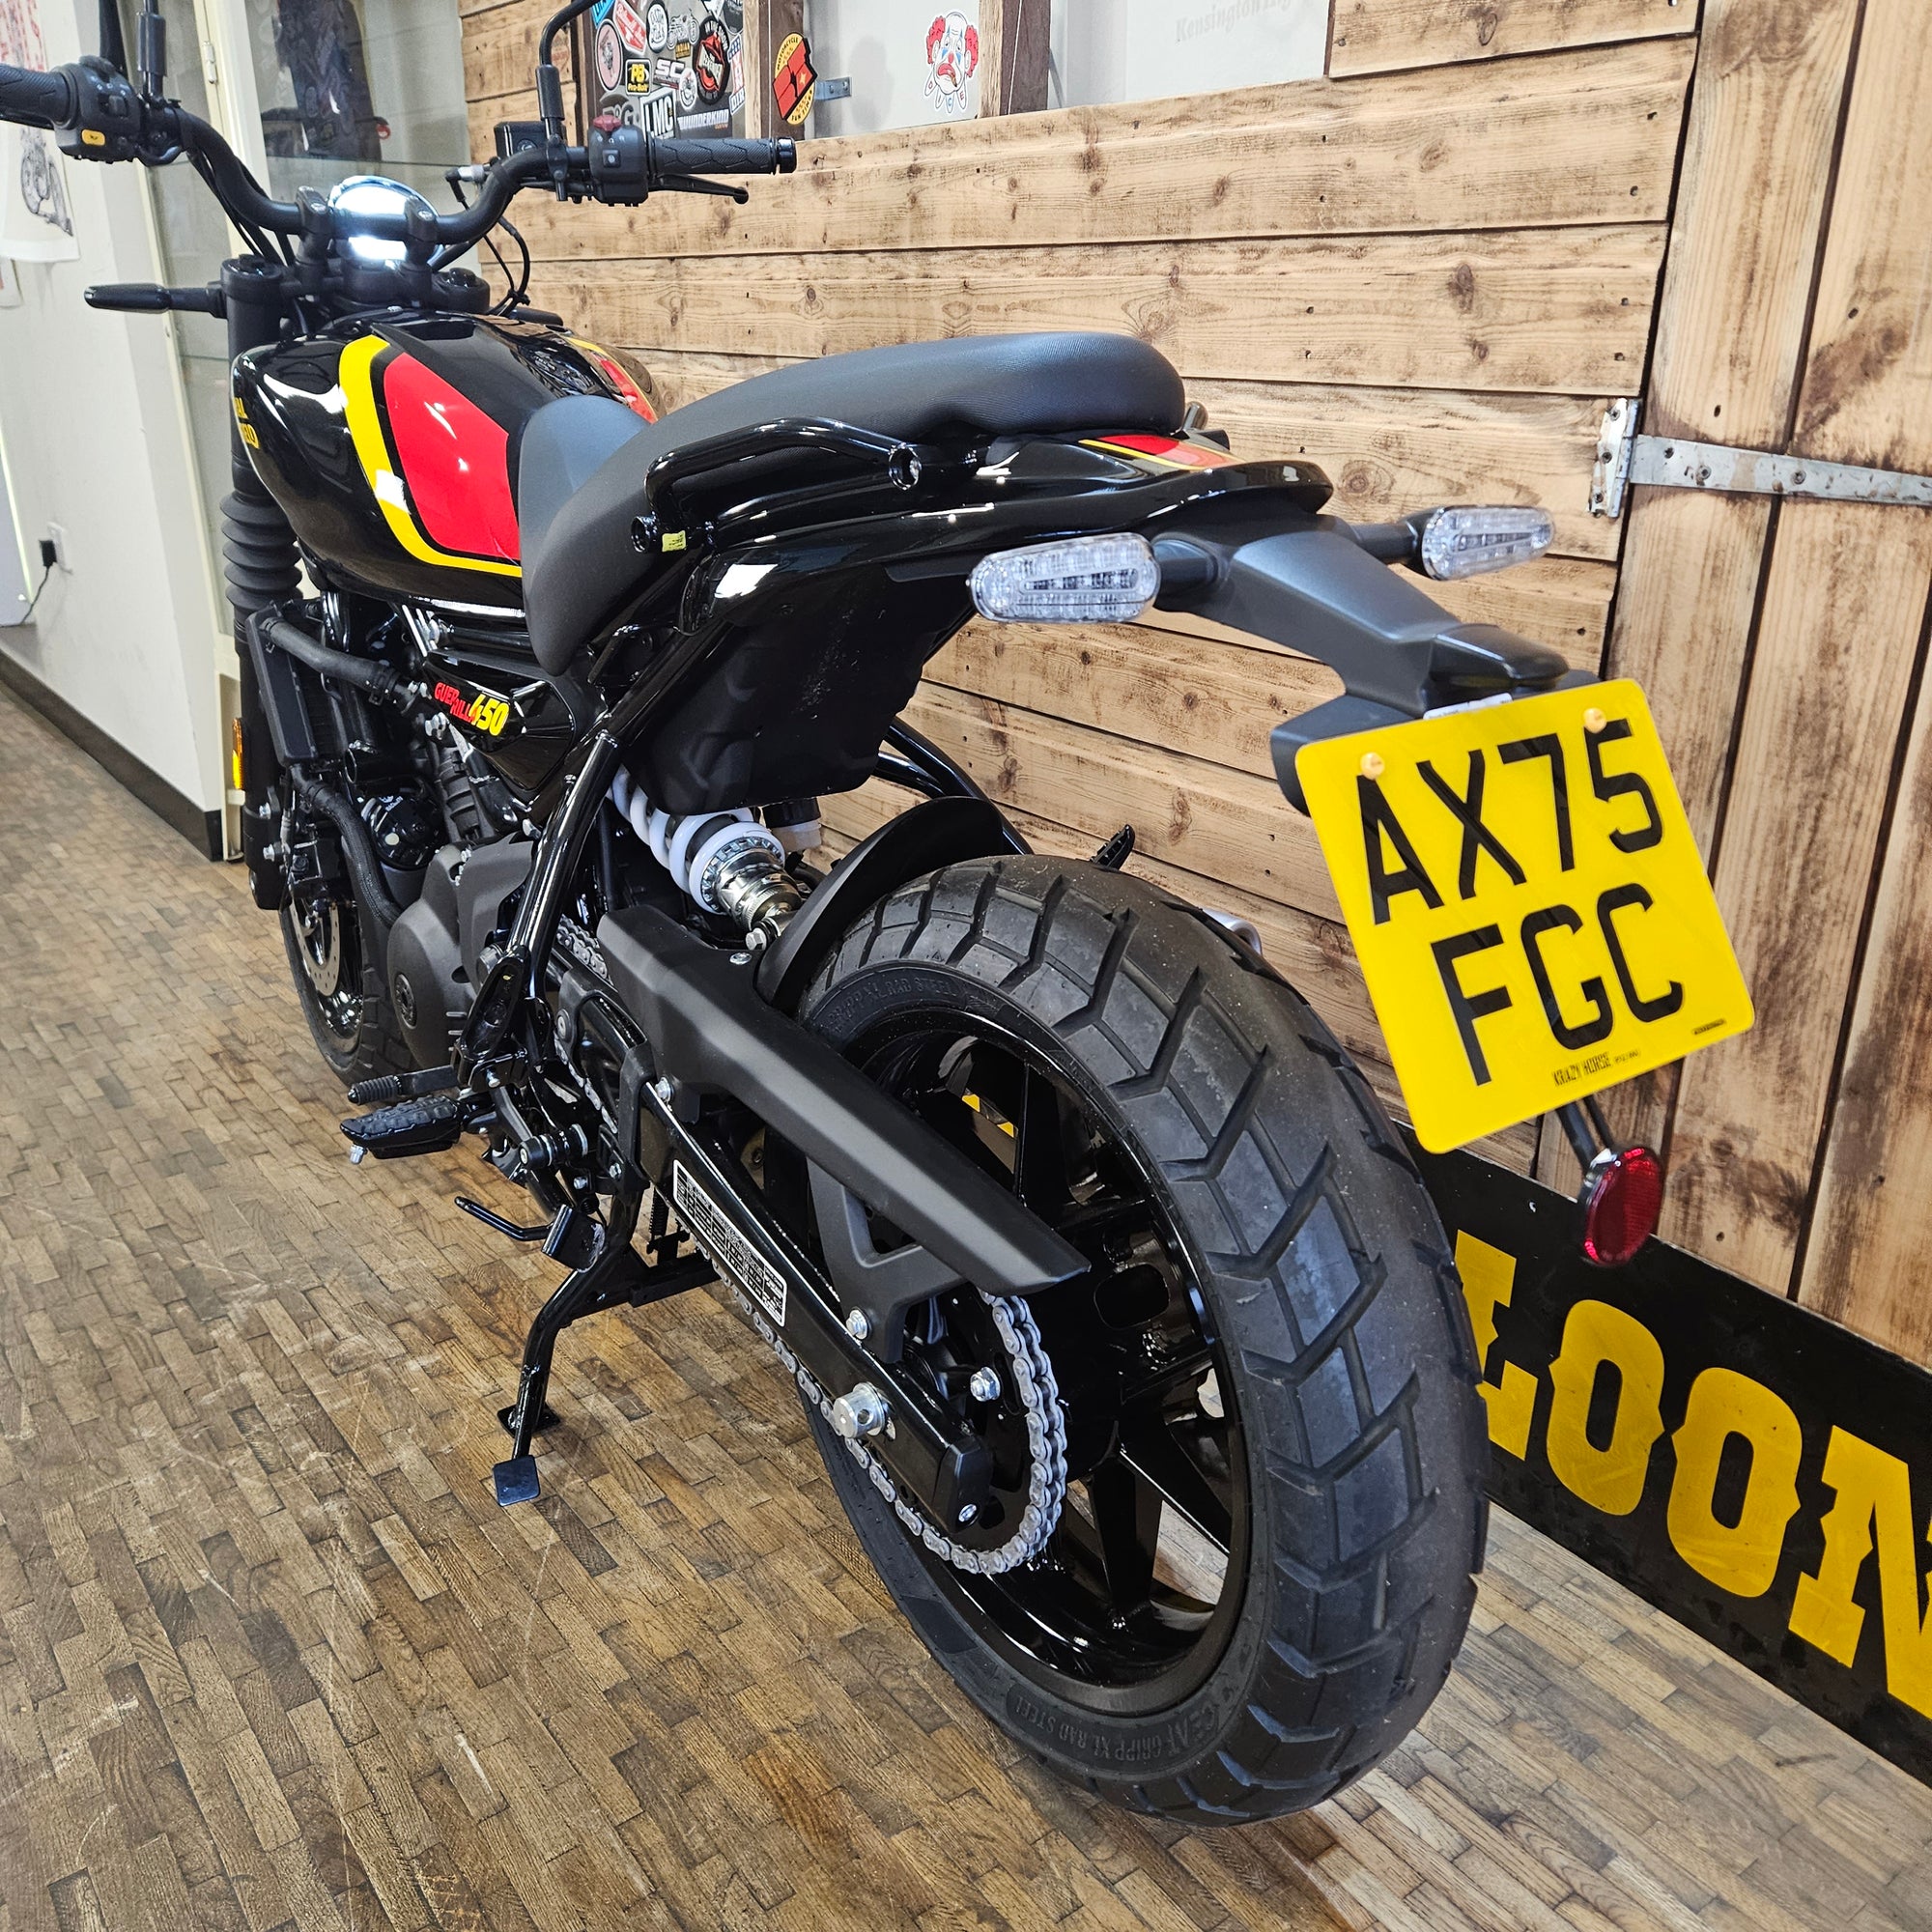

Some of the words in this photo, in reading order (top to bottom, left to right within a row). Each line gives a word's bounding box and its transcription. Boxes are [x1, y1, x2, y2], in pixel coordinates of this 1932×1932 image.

[631, 64, 645, 83] PB
[777, 37, 799, 71] MOTORCYCLE
[468, 693, 509, 736] 450
[1357, 718, 1663, 926] AX75
[1430, 883, 1683, 1087] FGC
